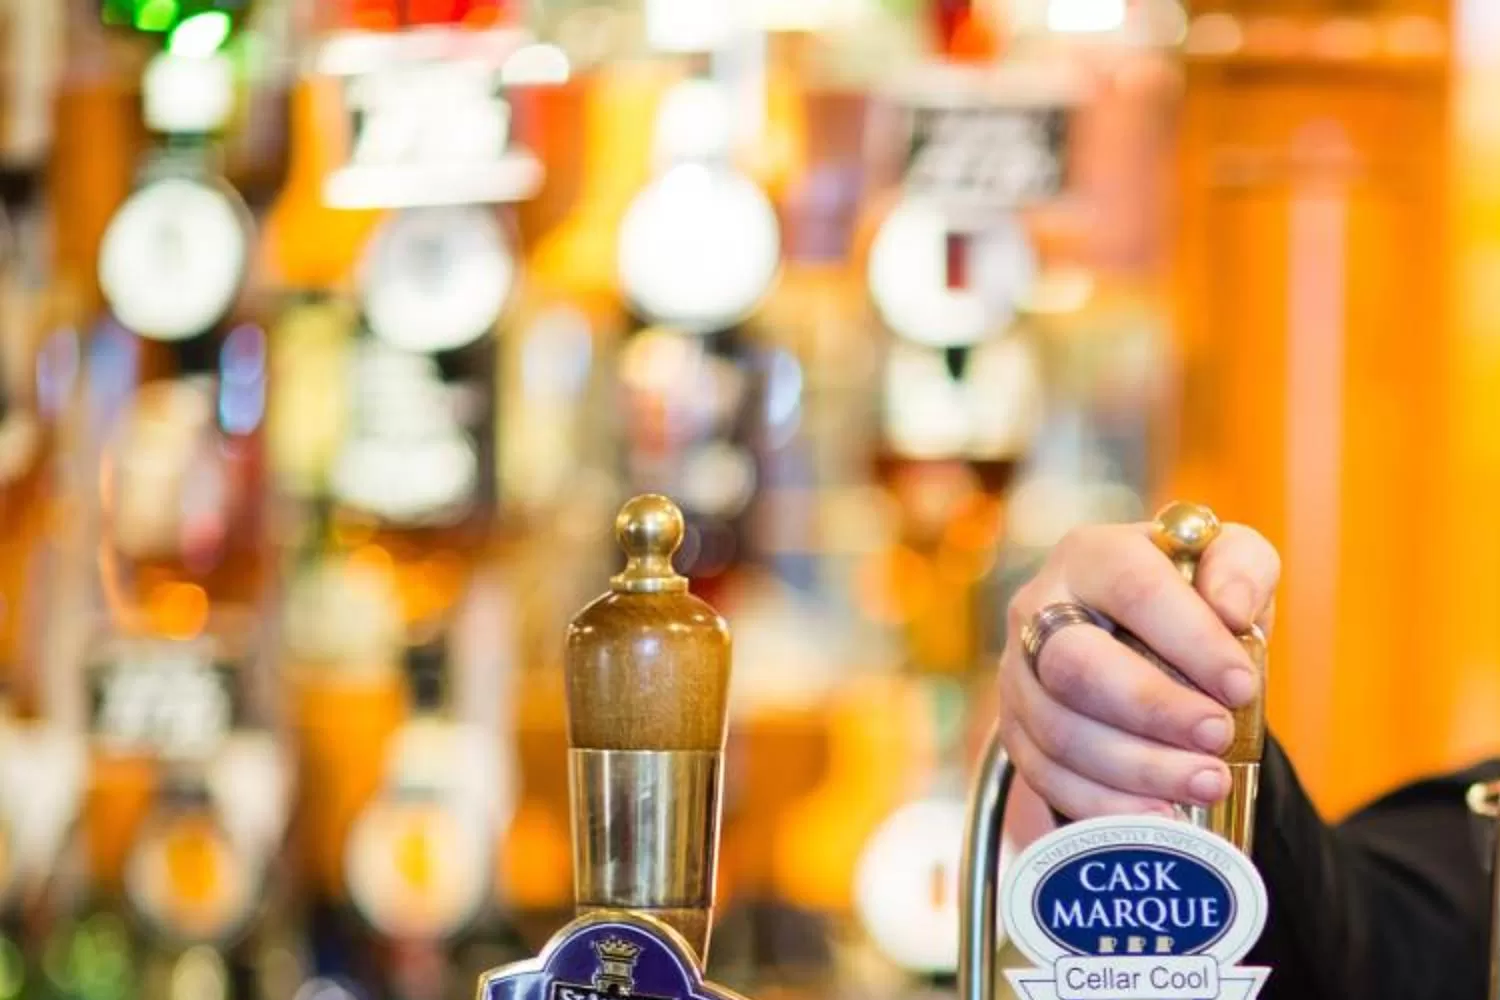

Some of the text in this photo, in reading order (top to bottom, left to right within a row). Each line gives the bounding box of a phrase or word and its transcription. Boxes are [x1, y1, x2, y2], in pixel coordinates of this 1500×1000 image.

[1079, 861, 1181, 892] CASK
[1052, 898, 1220, 931] MARQUE
[1066, 966, 1209, 991] Cellar Cool
